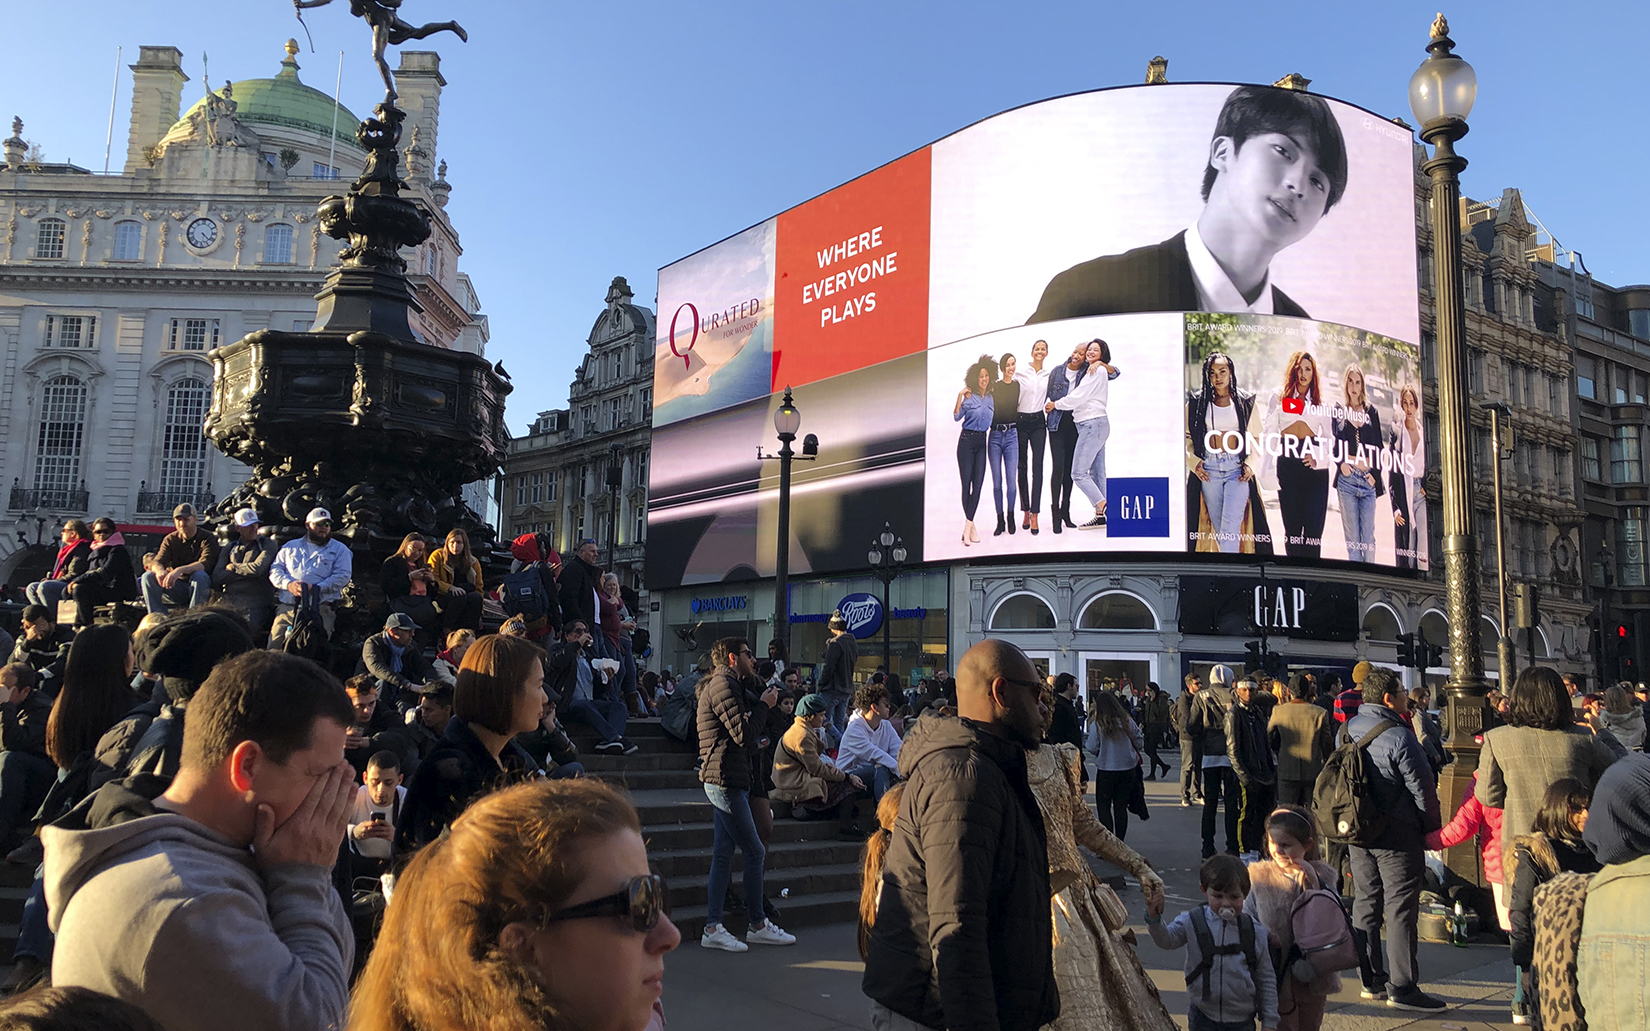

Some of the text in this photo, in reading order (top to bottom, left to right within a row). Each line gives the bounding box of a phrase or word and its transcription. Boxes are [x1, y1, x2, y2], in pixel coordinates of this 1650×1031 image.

[1375, 123, 1409, 145] HYUNDAI
[817, 226, 883, 269] WHERE
[802, 252, 898, 304] EVERYONE
[821, 291, 877, 328] PLAYS
[669, 298, 761, 372] QURATED
[723, 319, 759, 339] FOR WONDER
[1187, 323, 1203, 331] BRIT
[1205, 323, 1233, 332] AWARD
[1234, 324, 1267, 333] WINNERS
[1268, 326, 1284, 335] 2019
[1285, 327, 1299, 336] BRIT
[1304, 401, 1371, 424] YouTube Music
[1204, 427, 1416, 476] CONGRATULATIONS
[1121, 495, 1155, 520] GAP
[1189, 532, 1206, 540] BRIT
[1207, 533, 1236, 541] AWARD
[1237, 534, 1271, 543] WINNERS
[1290, 535, 1305, 546] BRIT
[1356, 541, 1368, 550] 2019
[701, 595, 747, 612] BARCLAYS
[842, 598, 877, 630] Boots
[893, 606, 926, 620] beauty
[1254, 585, 1305, 628] GAP
[789, 612, 828, 624] pharmacy
